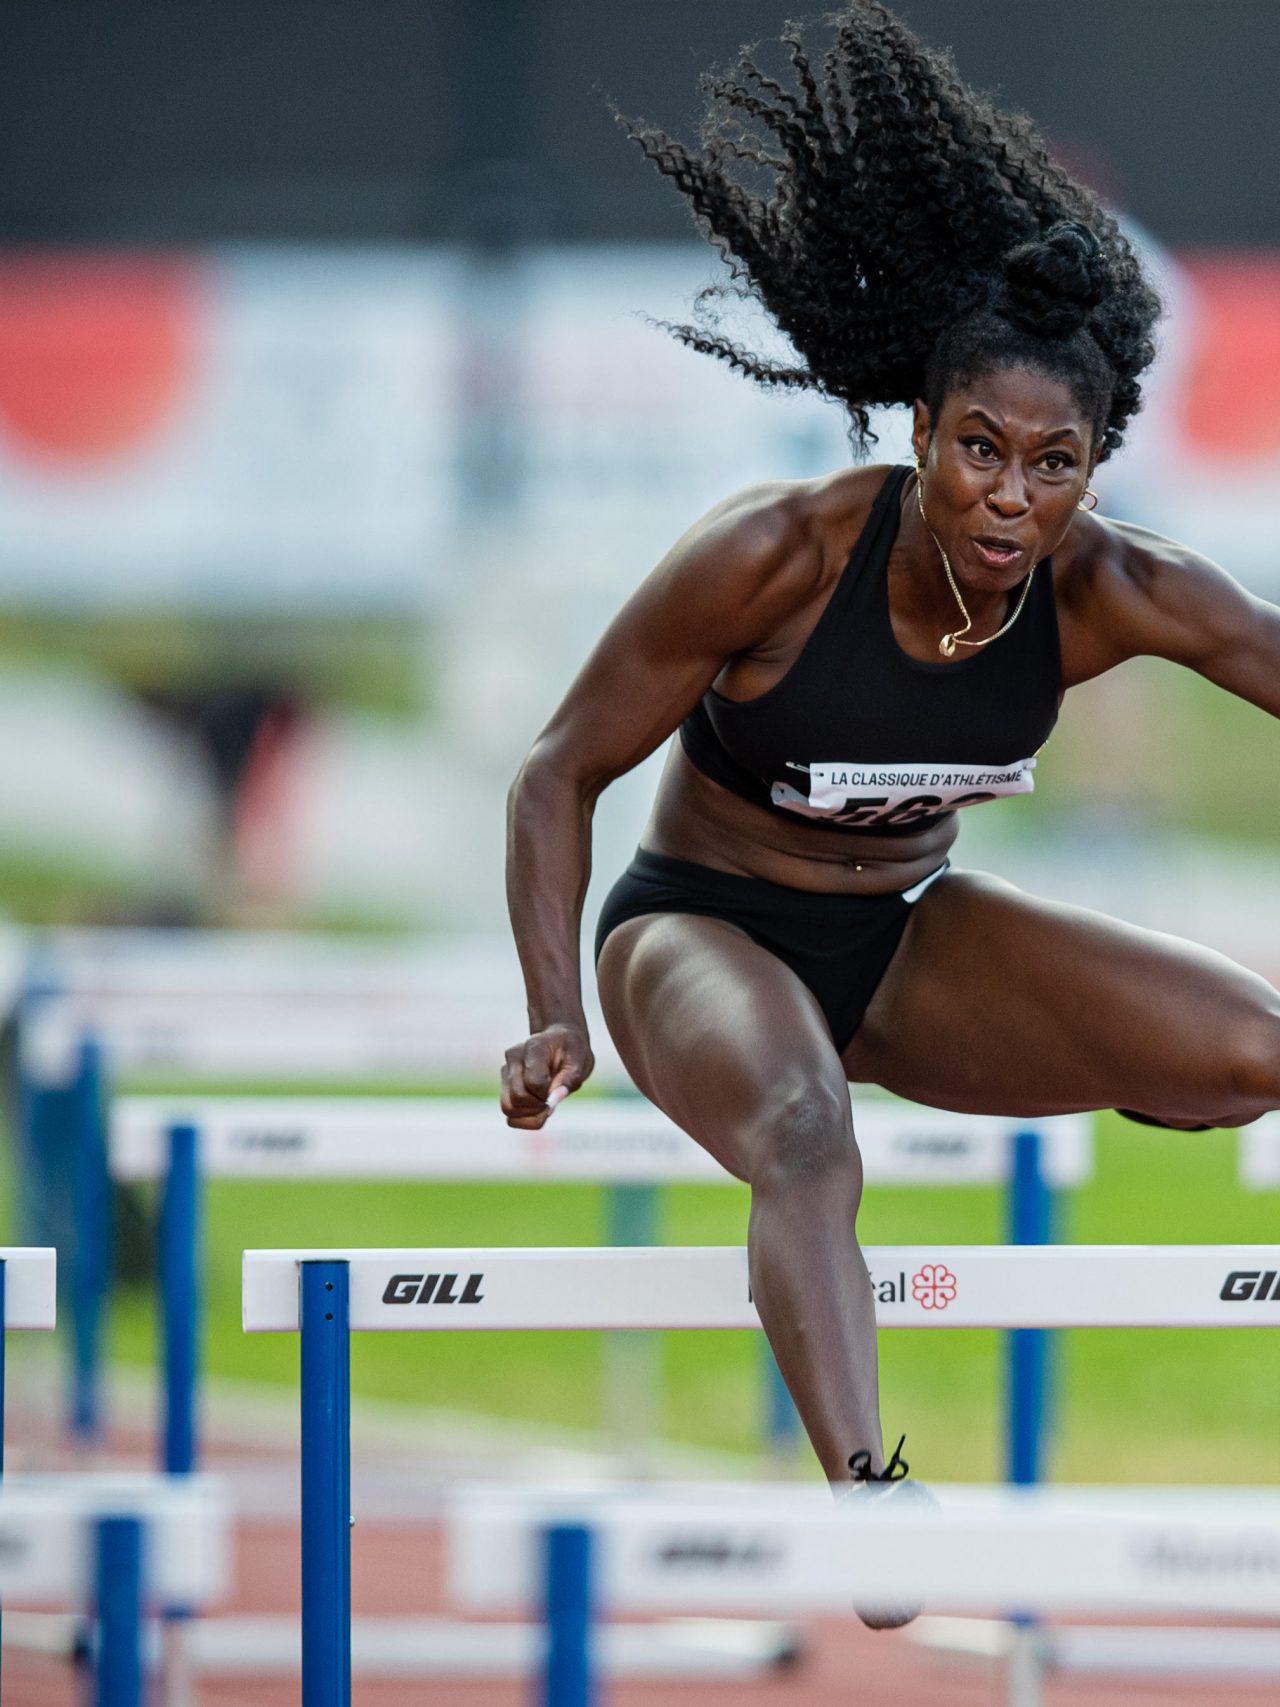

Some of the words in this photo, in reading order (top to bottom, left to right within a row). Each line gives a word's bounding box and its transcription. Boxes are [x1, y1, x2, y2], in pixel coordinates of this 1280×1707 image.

[831, 771, 848, 785] LA
[850, 772, 927, 786] CLASSIQUE
[929, 770, 1022, 786] D'ATHLÉTISME
[382, 1273, 484, 1304] GILL
